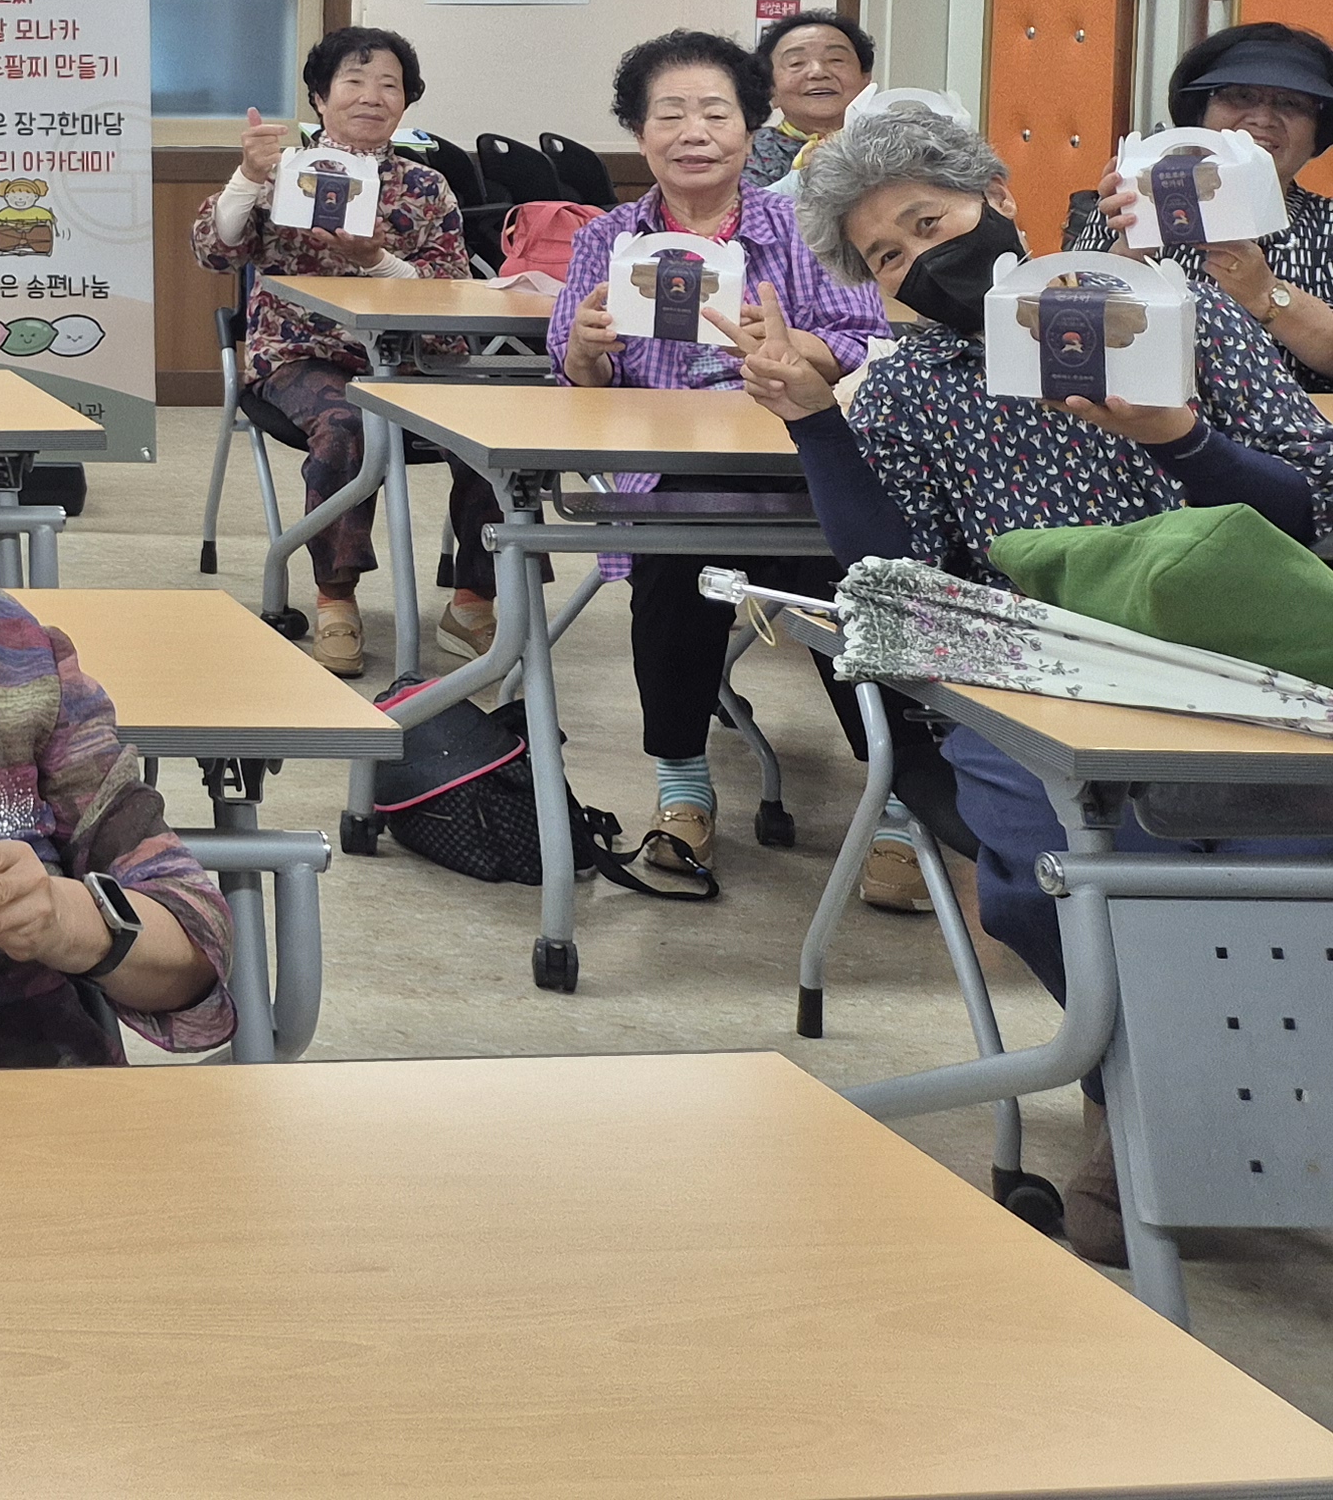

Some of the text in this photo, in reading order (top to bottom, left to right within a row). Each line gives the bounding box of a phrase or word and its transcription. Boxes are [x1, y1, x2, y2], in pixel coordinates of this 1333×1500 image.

[15, 19, 79, 40] 모나카
[56, 55, 117, 79] 만들기
[15, 112, 124, 136] 장구한마당
[27, 275, 109, 299] 송편나눔
